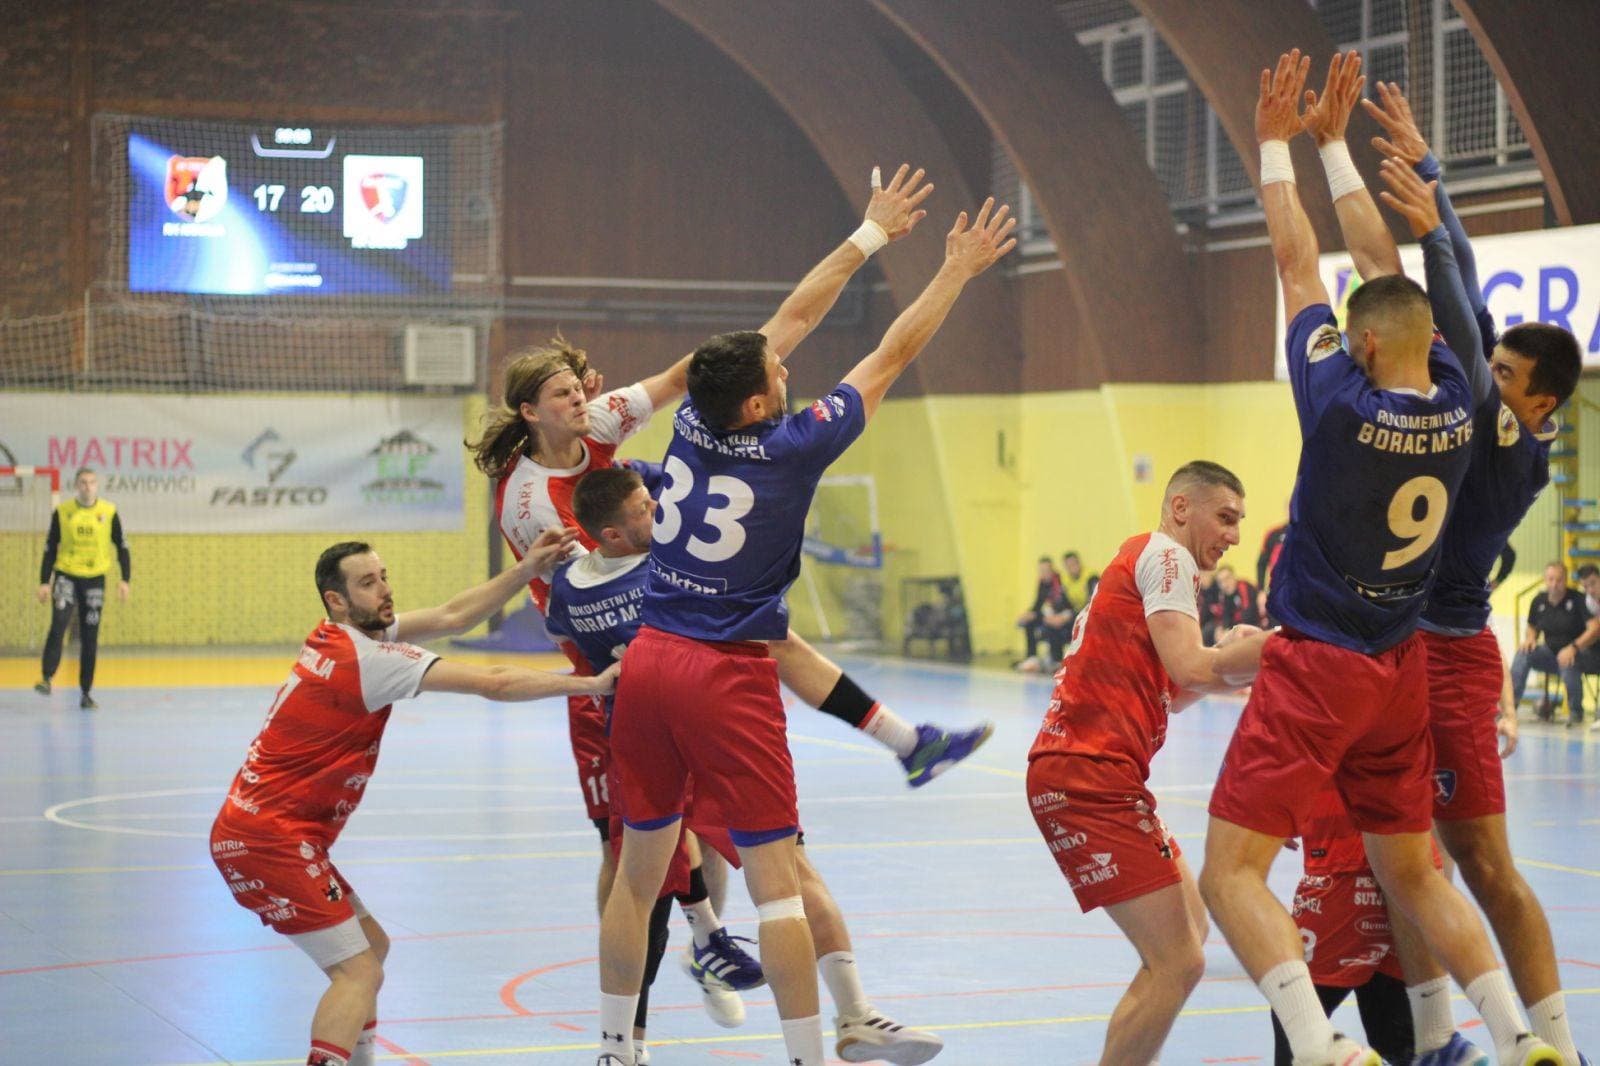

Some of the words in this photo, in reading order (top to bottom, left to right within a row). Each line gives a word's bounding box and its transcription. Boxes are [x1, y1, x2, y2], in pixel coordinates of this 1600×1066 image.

[254, 183, 285, 212] 17
[300, 185, 334, 213] 20
[48, 435, 194, 470] MATRIX
[728, 434, 759, 447] KLUB
[1357, 422, 1428, 455] BORAC
[209, 485, 328, 506] FASTCO
[519, 481, 533, 520] SARA
[651, 455, 755, 562] 33
[1381, 475, 1448, 571] 9
[1032, 791, 1067, 807] MATRIX
[1080, 863, 1119, 886] PLANET
